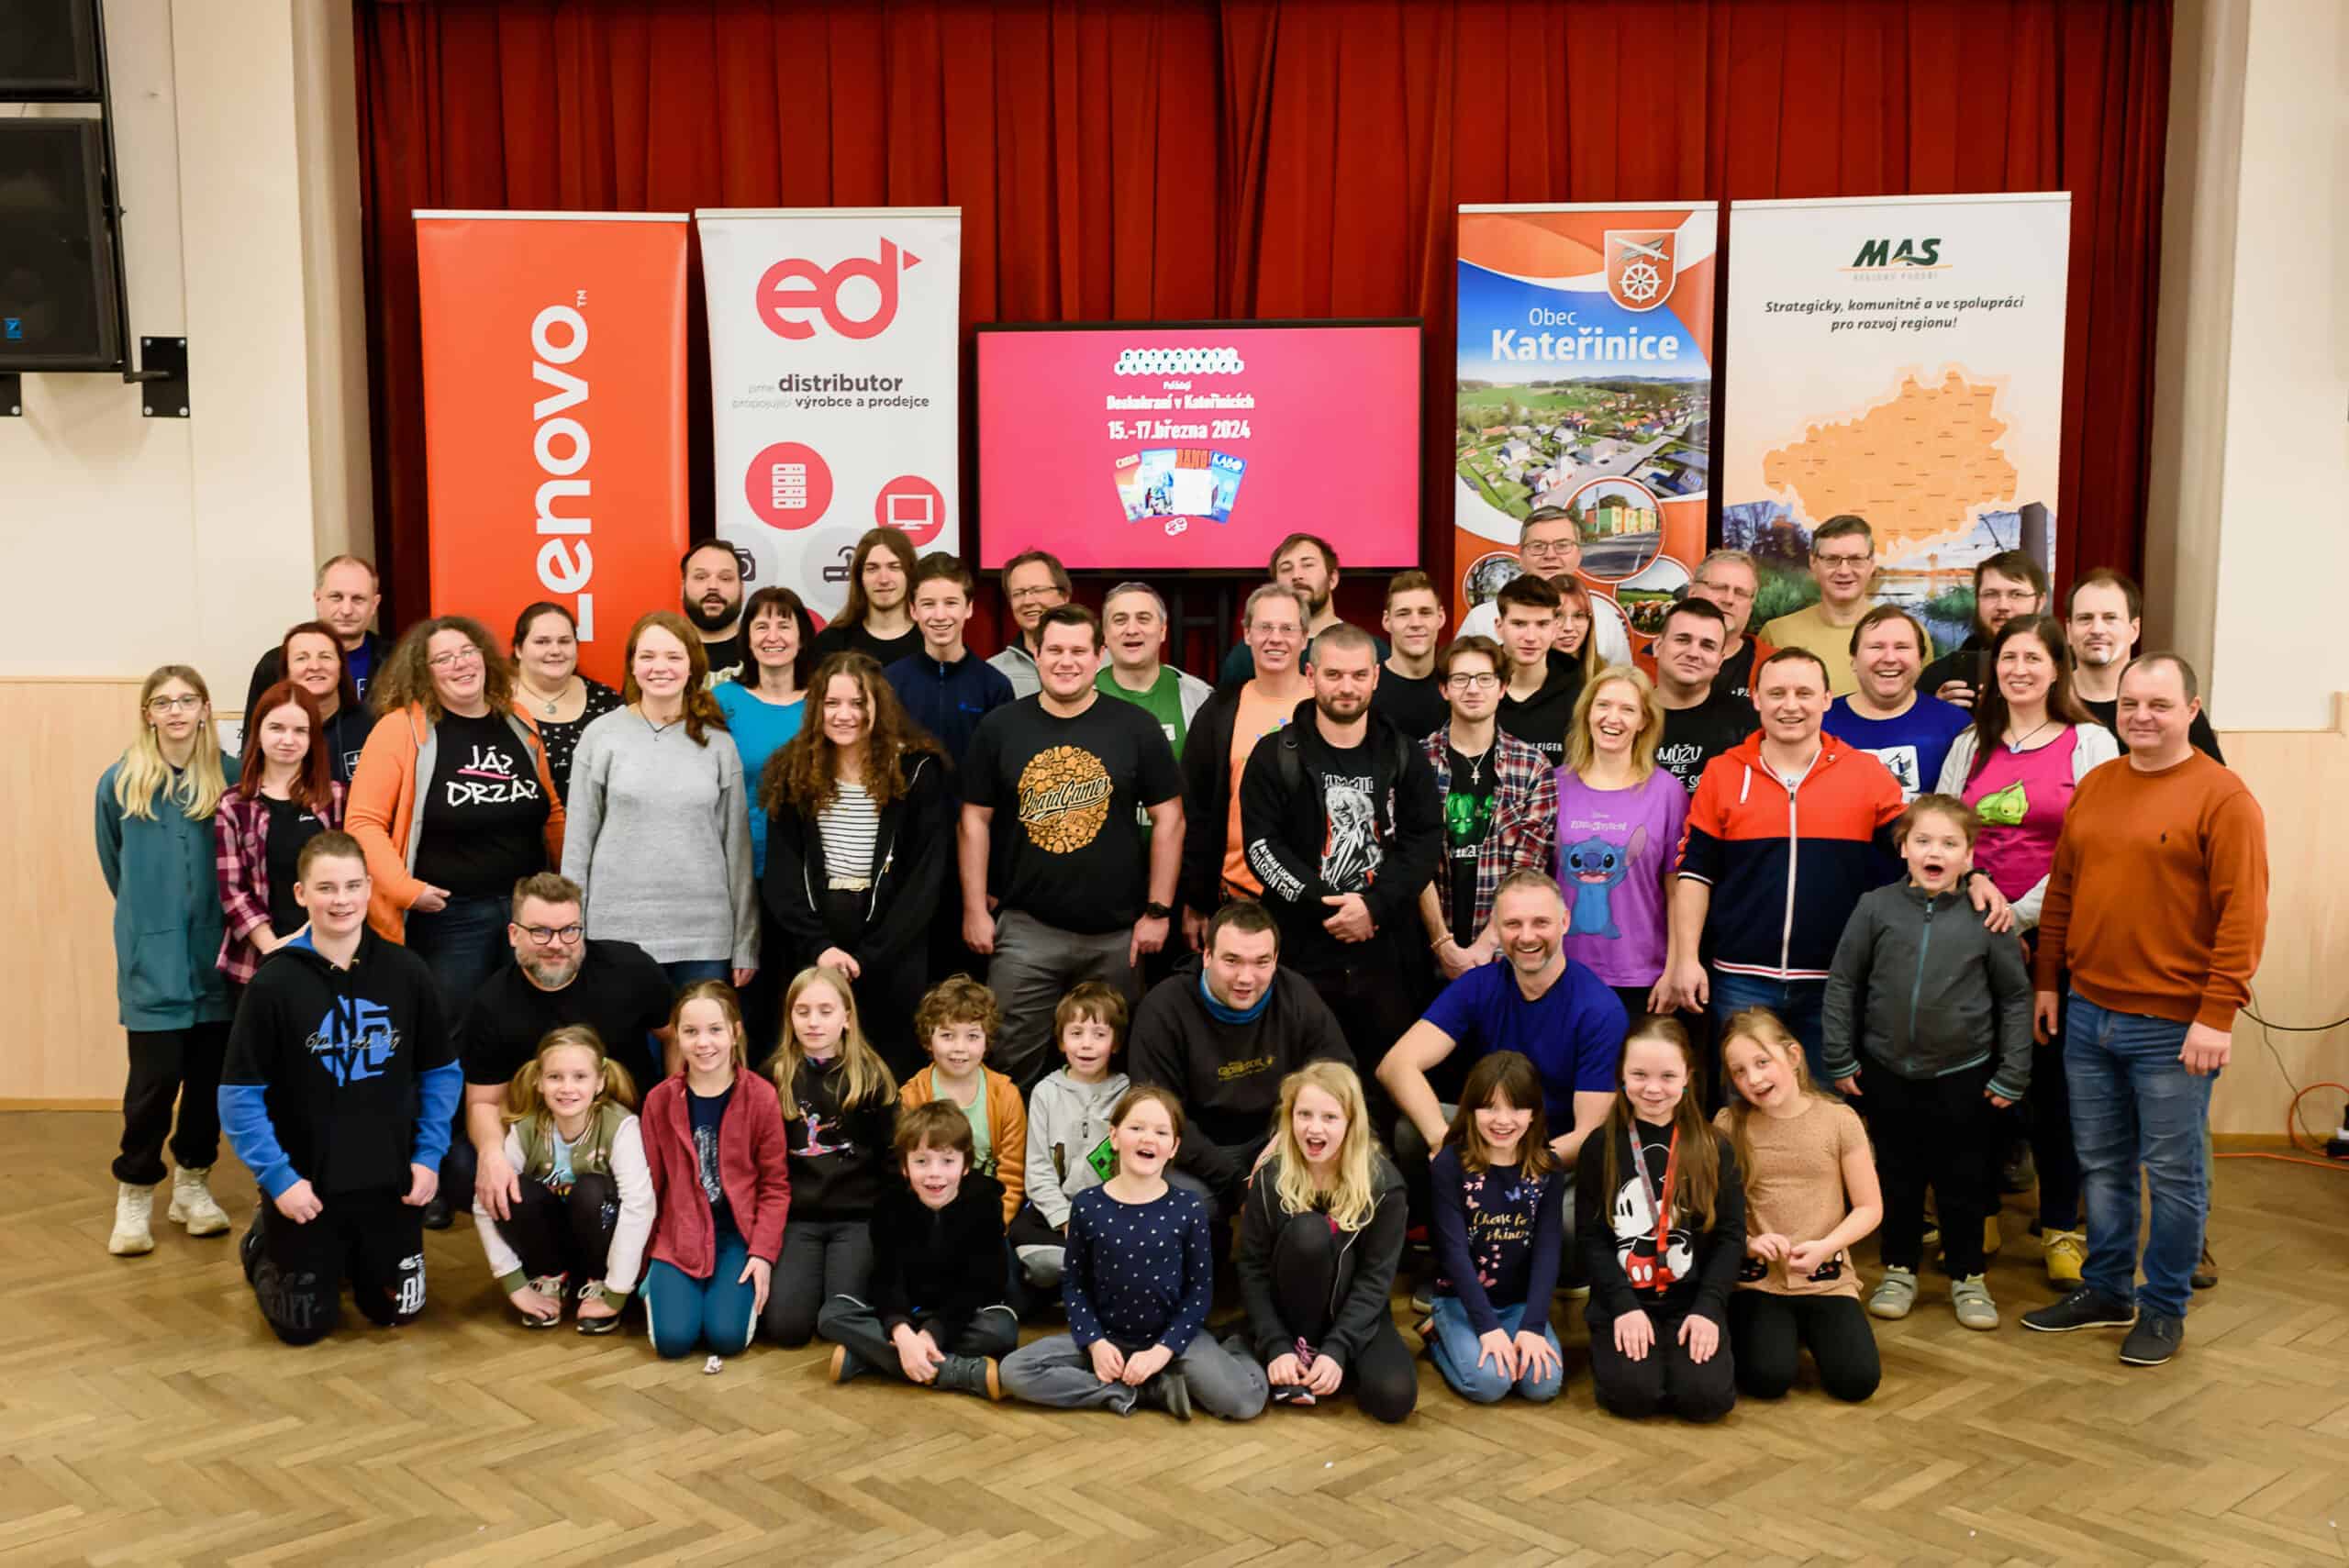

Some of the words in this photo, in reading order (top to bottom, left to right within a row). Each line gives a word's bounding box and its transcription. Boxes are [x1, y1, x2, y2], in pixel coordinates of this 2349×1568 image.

[1853, 239, 1942, 266] MAS
[1765, 300, 1844, 314] Strategicky,
[1847, 297, 1920, 311] komunitně
[1924, 301, 1932, 309] a
[1936, 301, 1950, 309] ve
[1954, 295, 2024, 311] spolupráci
[1529, 307, 1577, 326] Obec
[1831, 320, 1854, 332] pro
[1857, 317, 1898, 331] rozvoj
[1900, 317, 1957, 331] regionu!
[1491, 327, 1679, 361] Kateřinice
[779, 373, 903, 392] distributor
[796, 396, 852, 409] výrobce
[857, 398, 864, 406] a
[868, 395, 930, 409] prodejce
[1174, 398, 1183, 409] v
[1211, 419, 1252, 439] 2024
[464, 745, 514, 774] JÁ?
[1656, 744, 1703, 763] MŮŽU
[446, 774, 540, 807] DRZÁ?
